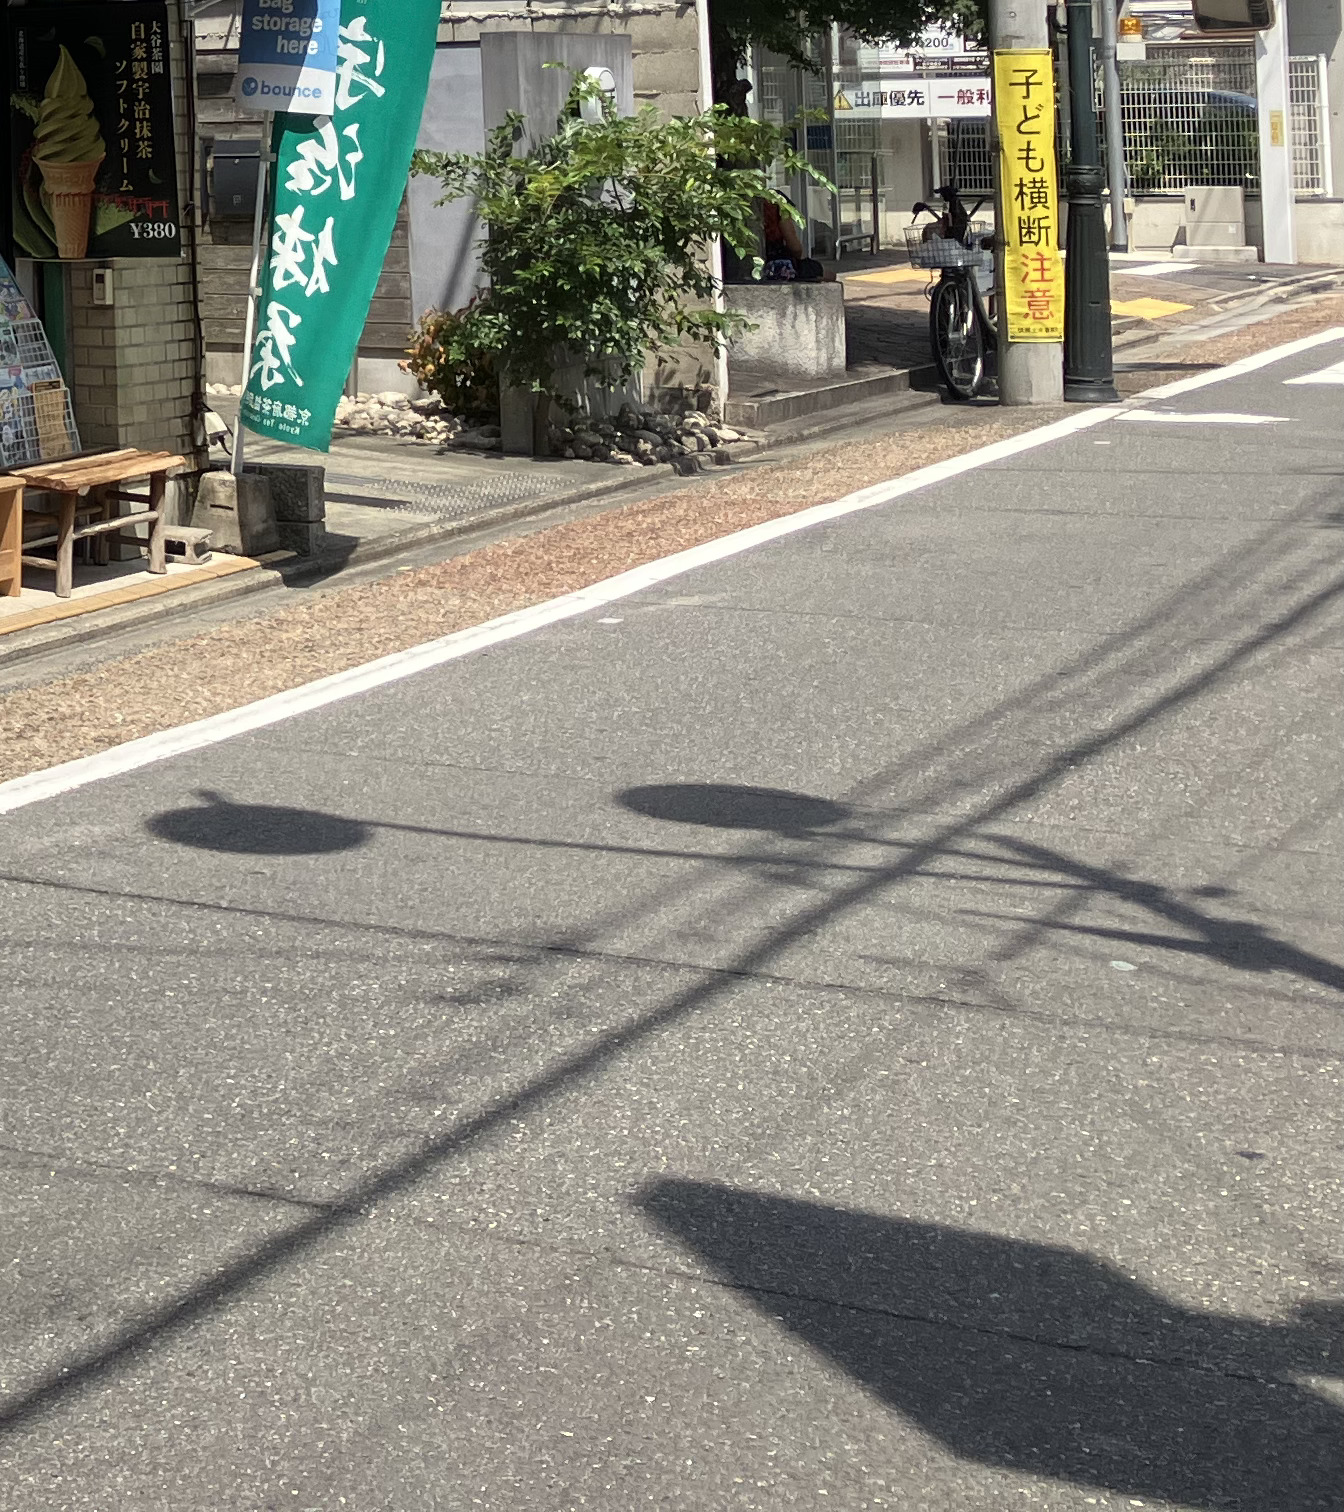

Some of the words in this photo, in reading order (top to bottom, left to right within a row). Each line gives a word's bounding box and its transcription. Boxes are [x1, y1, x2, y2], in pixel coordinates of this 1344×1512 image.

[251, 14, 323, 36] storage
[150, 20, 164, 74] 大谷茶園
[276, 35, 319, 54] here
[129, 21, 153, 159] 自家製宇治抹茶
[260, 79, 323, 99] bounce
[854, 89, 925, 108] 出庫優先
[114, 60, 134, 191] ソフトクリーム
[1008, 68, 1055, 321] 子ども横断注意
[129, 222, 176, 239] ¥380
